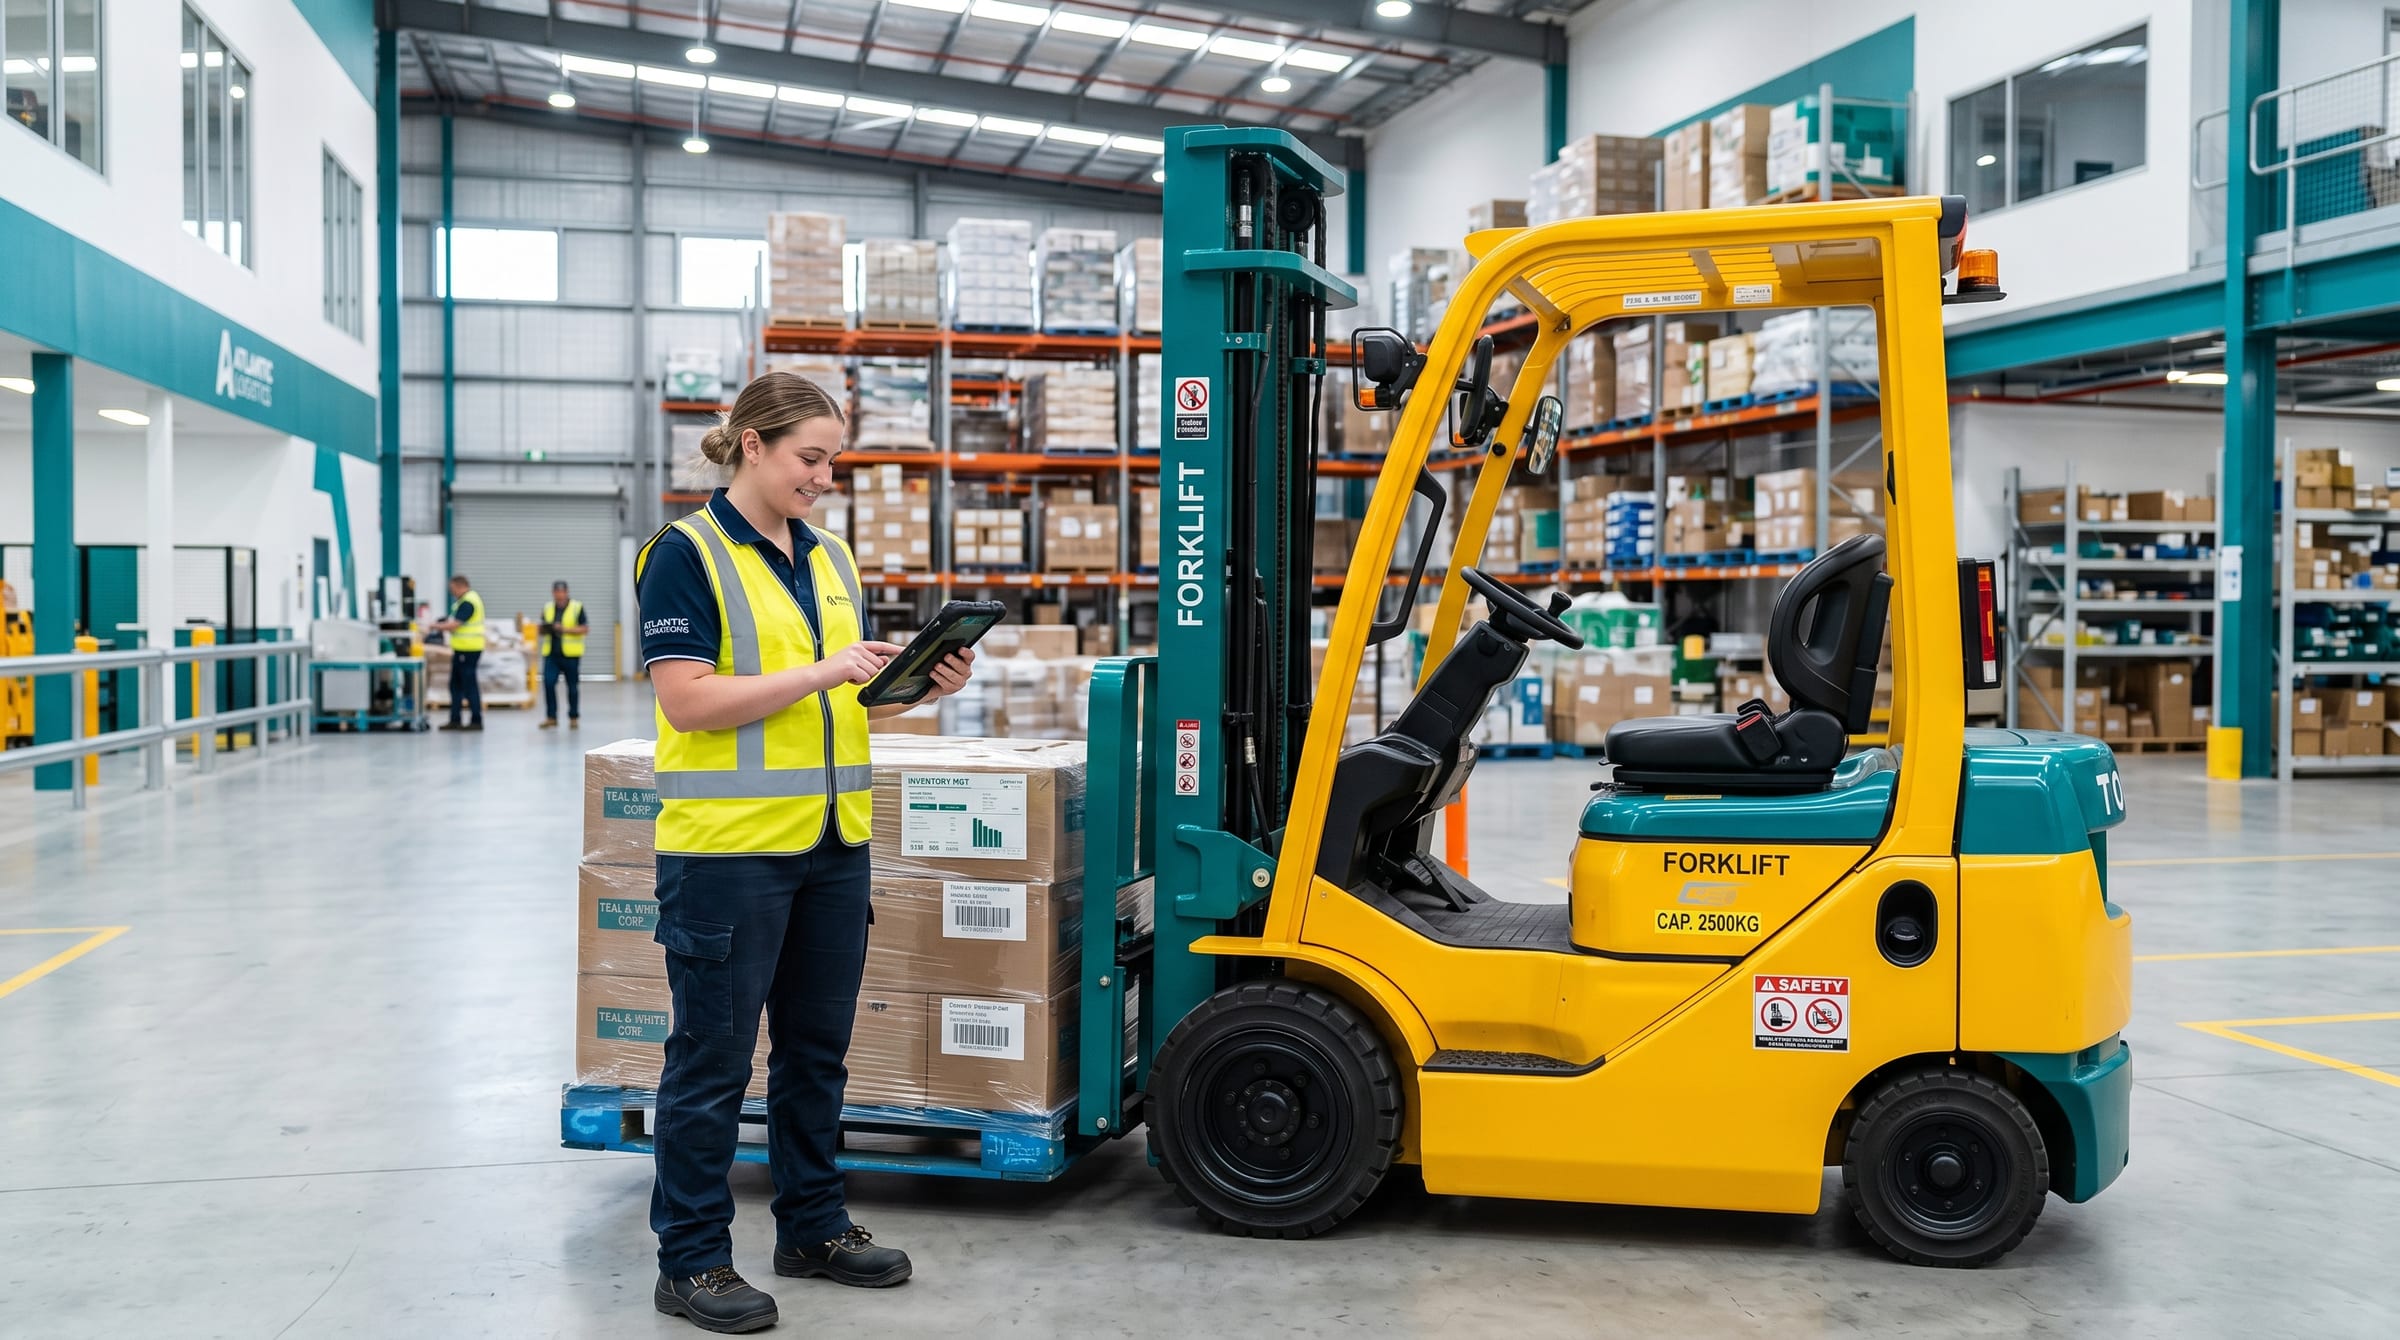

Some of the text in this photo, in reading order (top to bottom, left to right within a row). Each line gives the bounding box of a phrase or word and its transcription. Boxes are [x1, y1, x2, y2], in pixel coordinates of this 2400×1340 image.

[1177, 462, 1205, 626] FORKLIFT
[643, 618, 689, 631] ATLANTIC
[908, 777, 970, 786] INVENTORY MGT
[606, 791, 630, 802] TEAL
[632, 792, 639, 802] &
[1663, 851, 1790, 876] FORKLIFT
[600, 902, 660, 915] TEAL & WHIT
[1657, 912, 1760, 933] CAP. 2500KG
[1779, 978, 1844, 993] SAFETY
[599, 1011, 666, 1026] TEAL & WHITE
